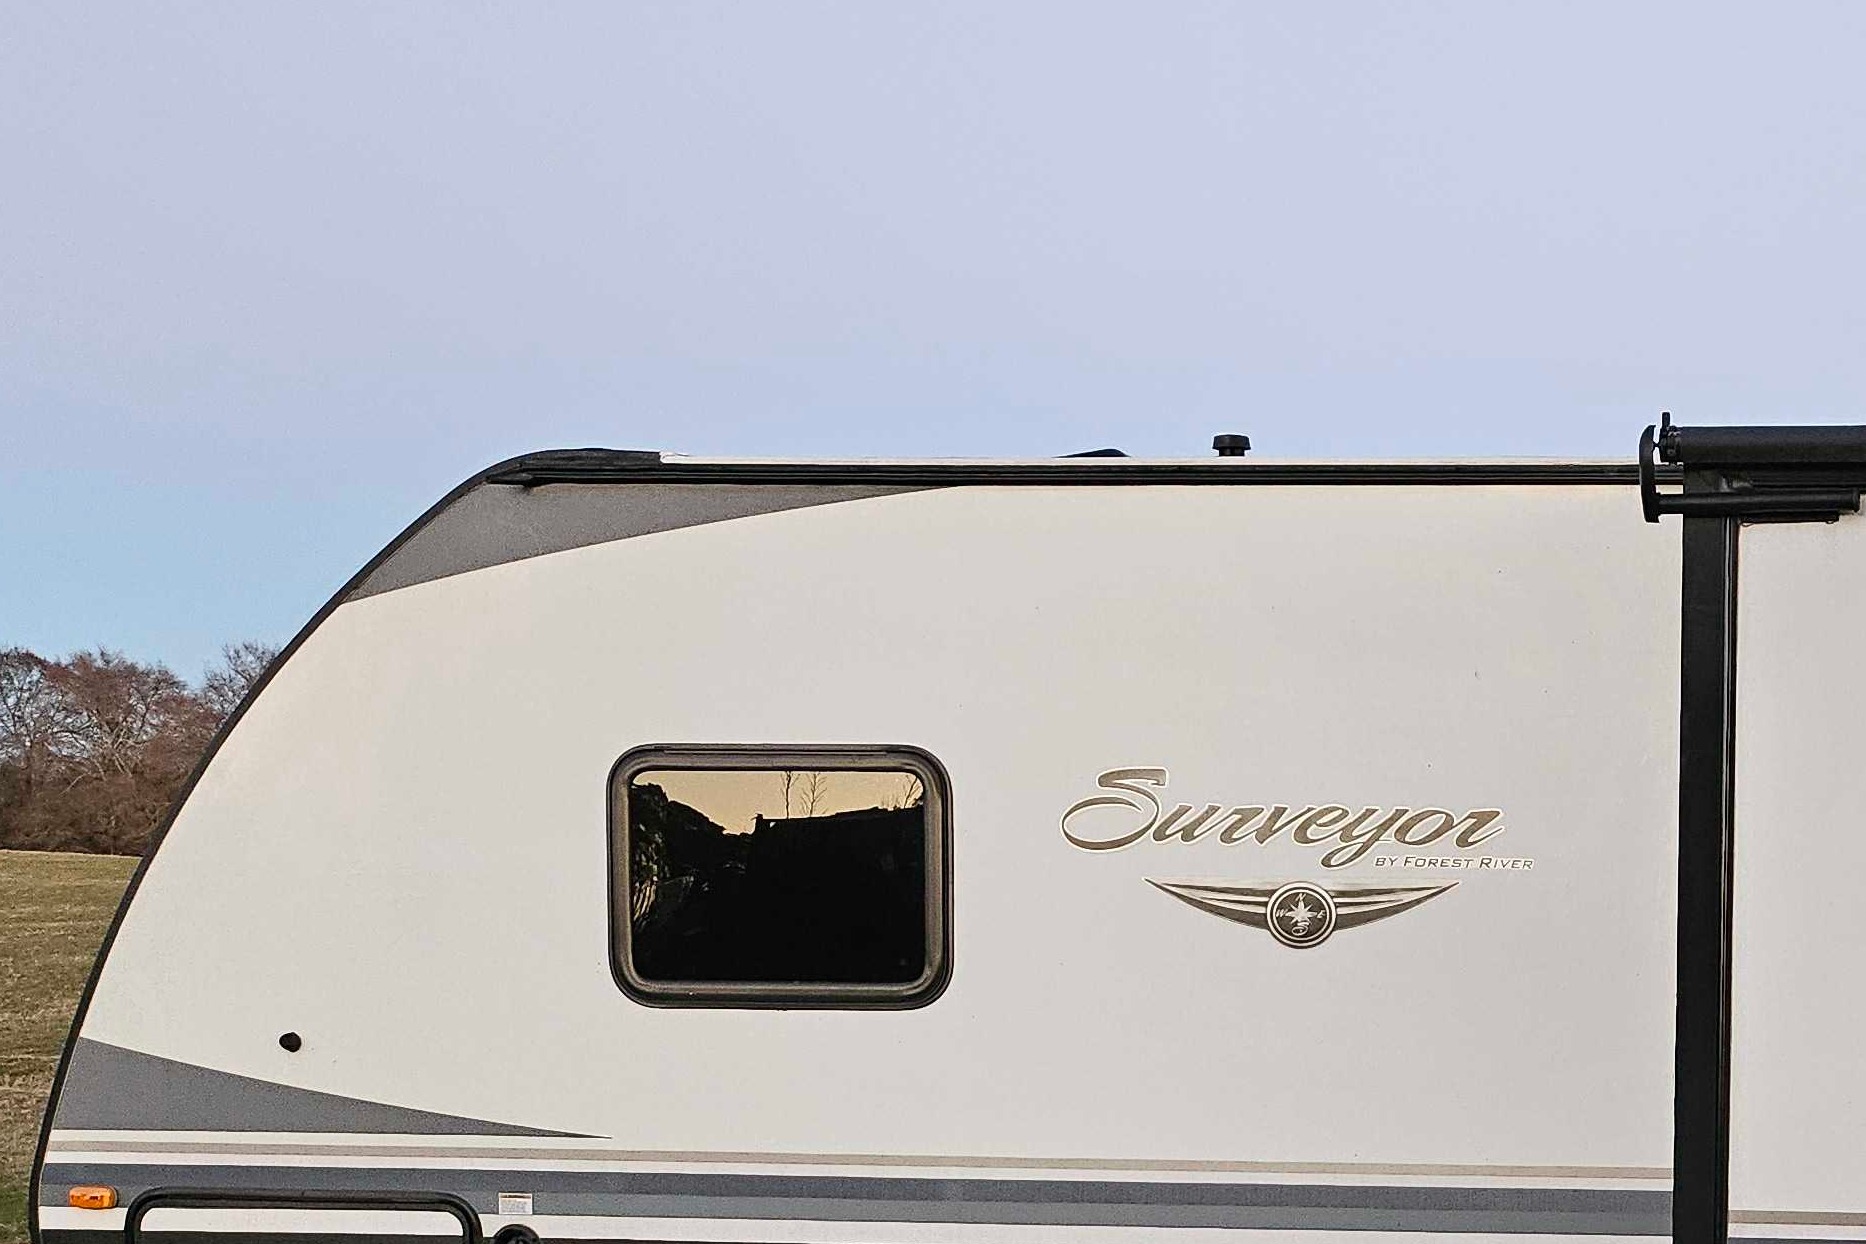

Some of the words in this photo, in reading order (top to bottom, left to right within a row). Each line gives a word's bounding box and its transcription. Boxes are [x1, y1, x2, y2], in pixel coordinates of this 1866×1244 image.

[1061, 767, 1504, 869] Surveyor
[1375, 856, 1399, 867] BY
[1403, 856, 1475, 868] FOREST
[1479, 857, 1534, 870] RIVER
